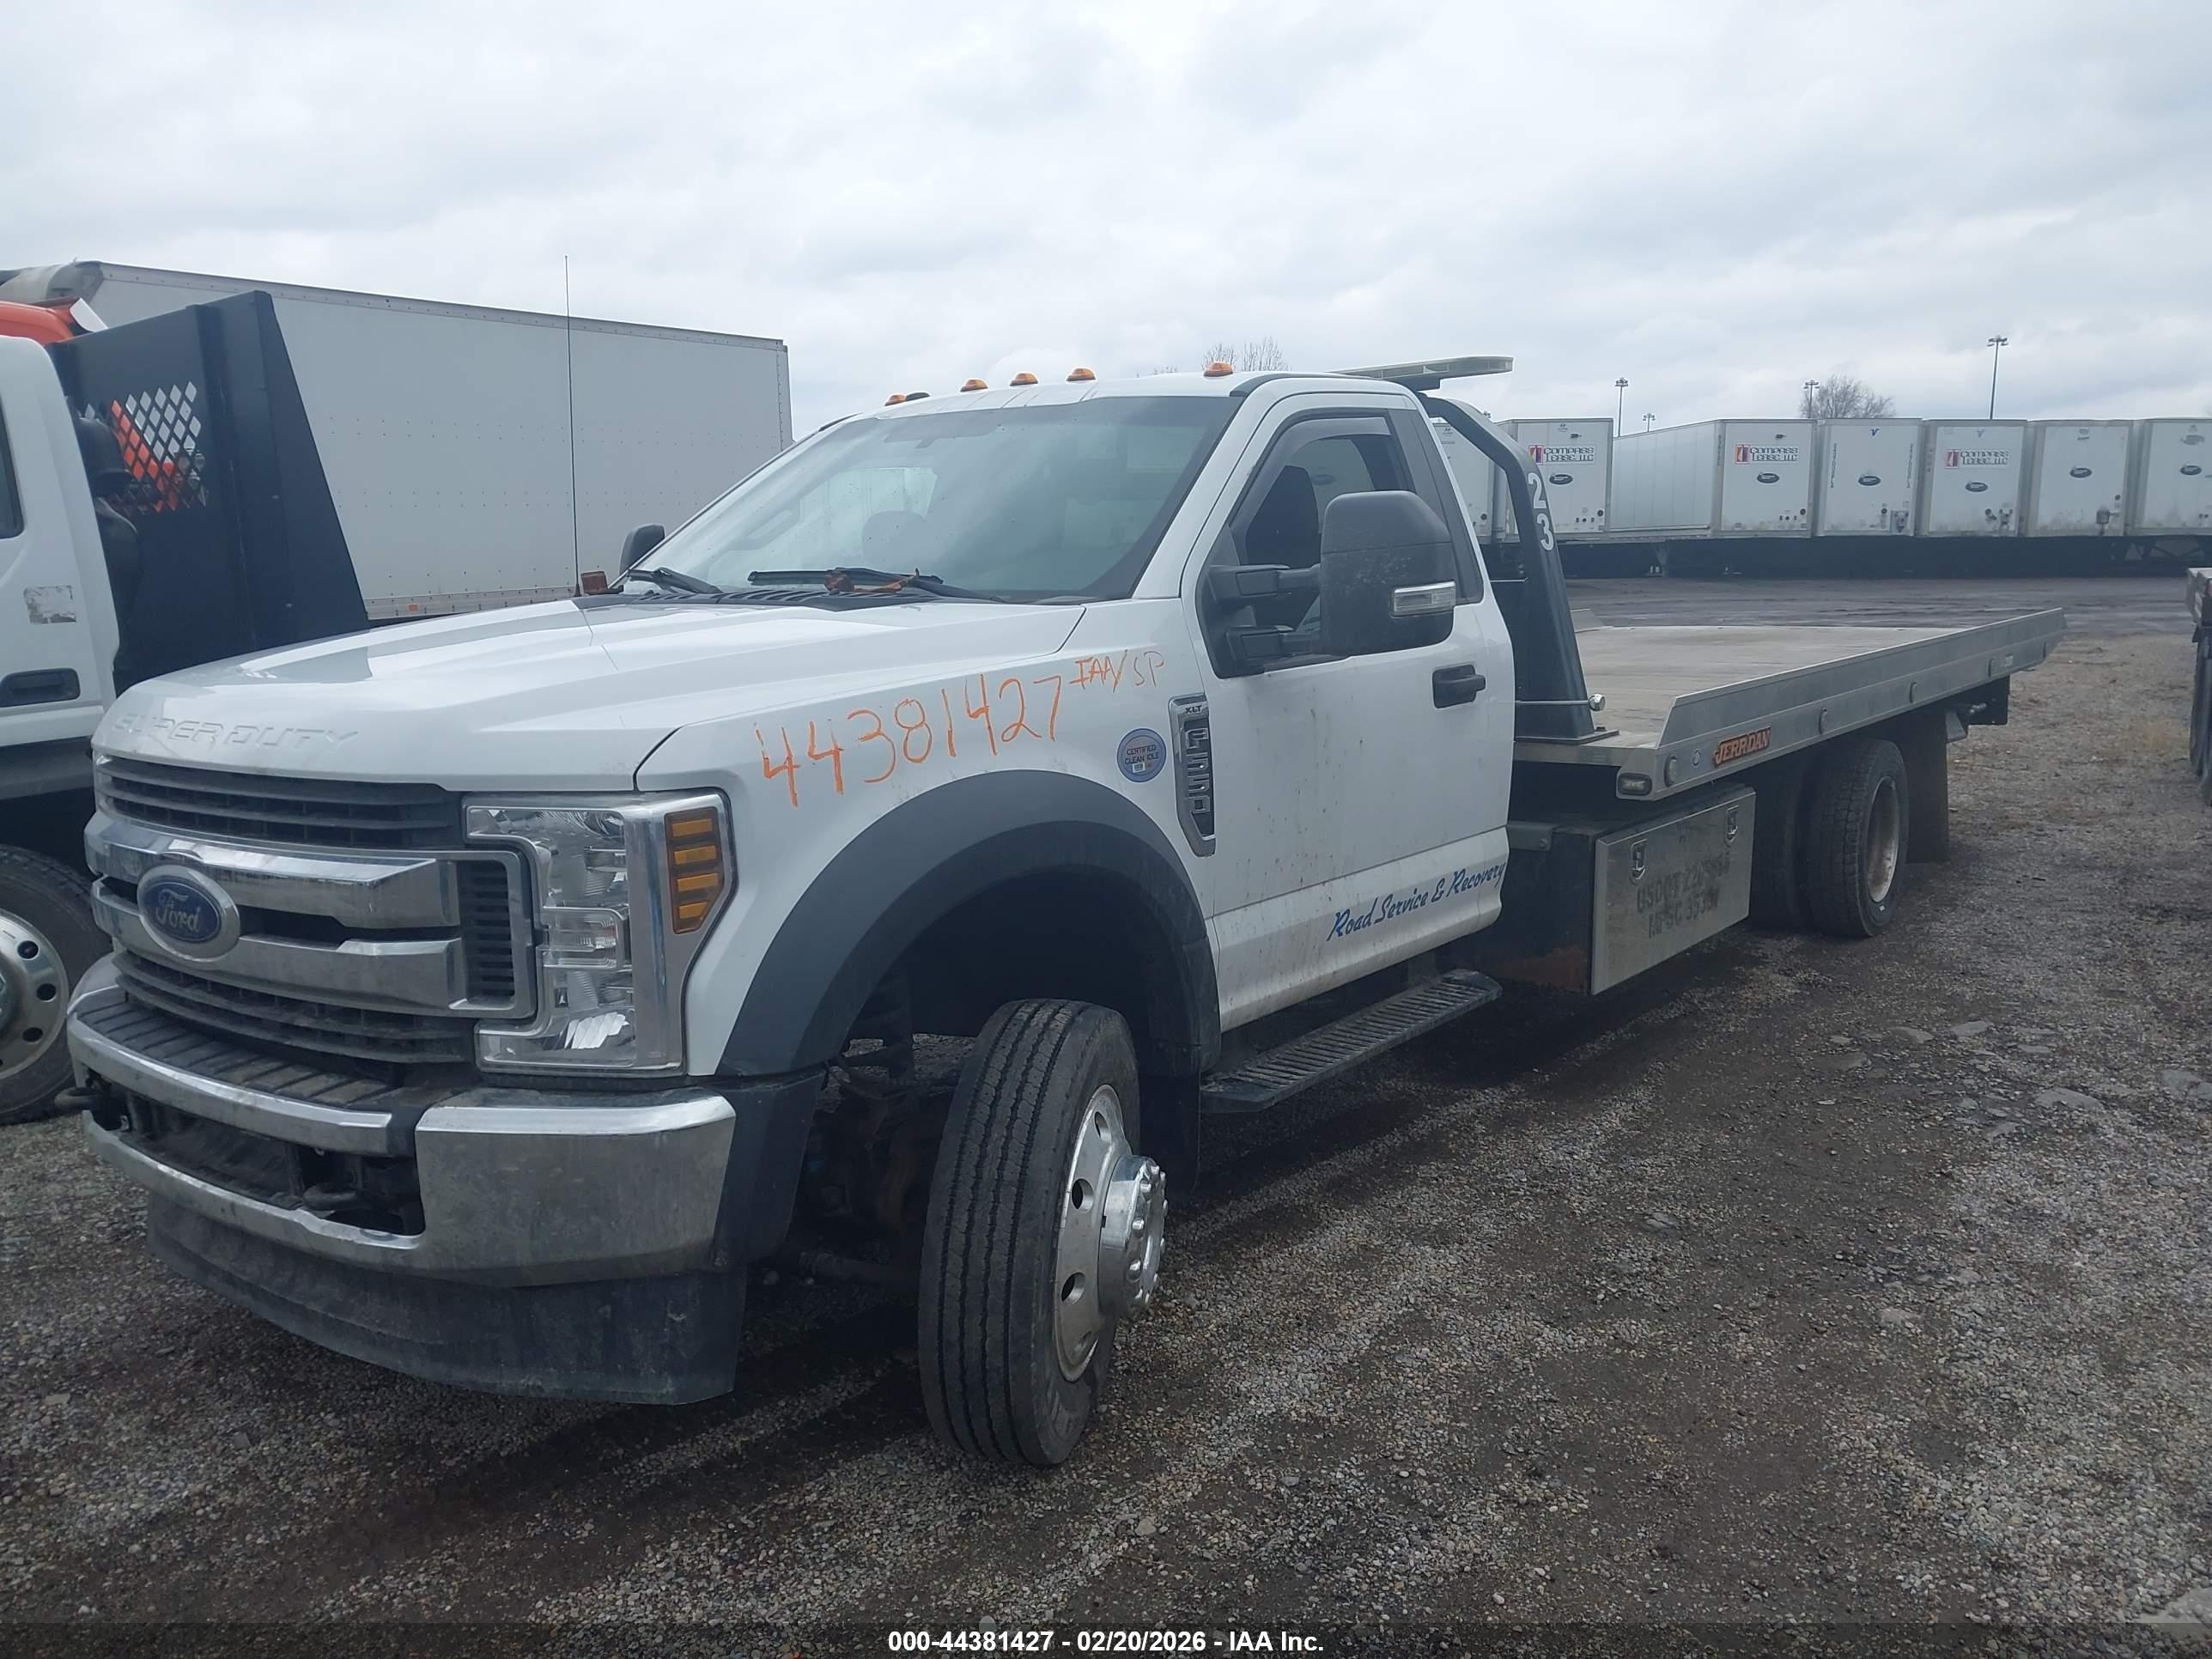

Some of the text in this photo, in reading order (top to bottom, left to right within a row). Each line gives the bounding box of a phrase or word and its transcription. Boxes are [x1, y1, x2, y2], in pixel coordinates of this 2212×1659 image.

[1185, 705, 1202, 715] XLT
[225, 725, 358, 747] DUTY
[755, 673, 1062, 807] 44381427
[1125, 751, 1159, 764] CLEAN IDLE
[1126, 744, 1157, 756] CERTIFIED
[155, 888, 202, 933] Ford
[1326, 861, 1507, 942] Road Service & Recovery
